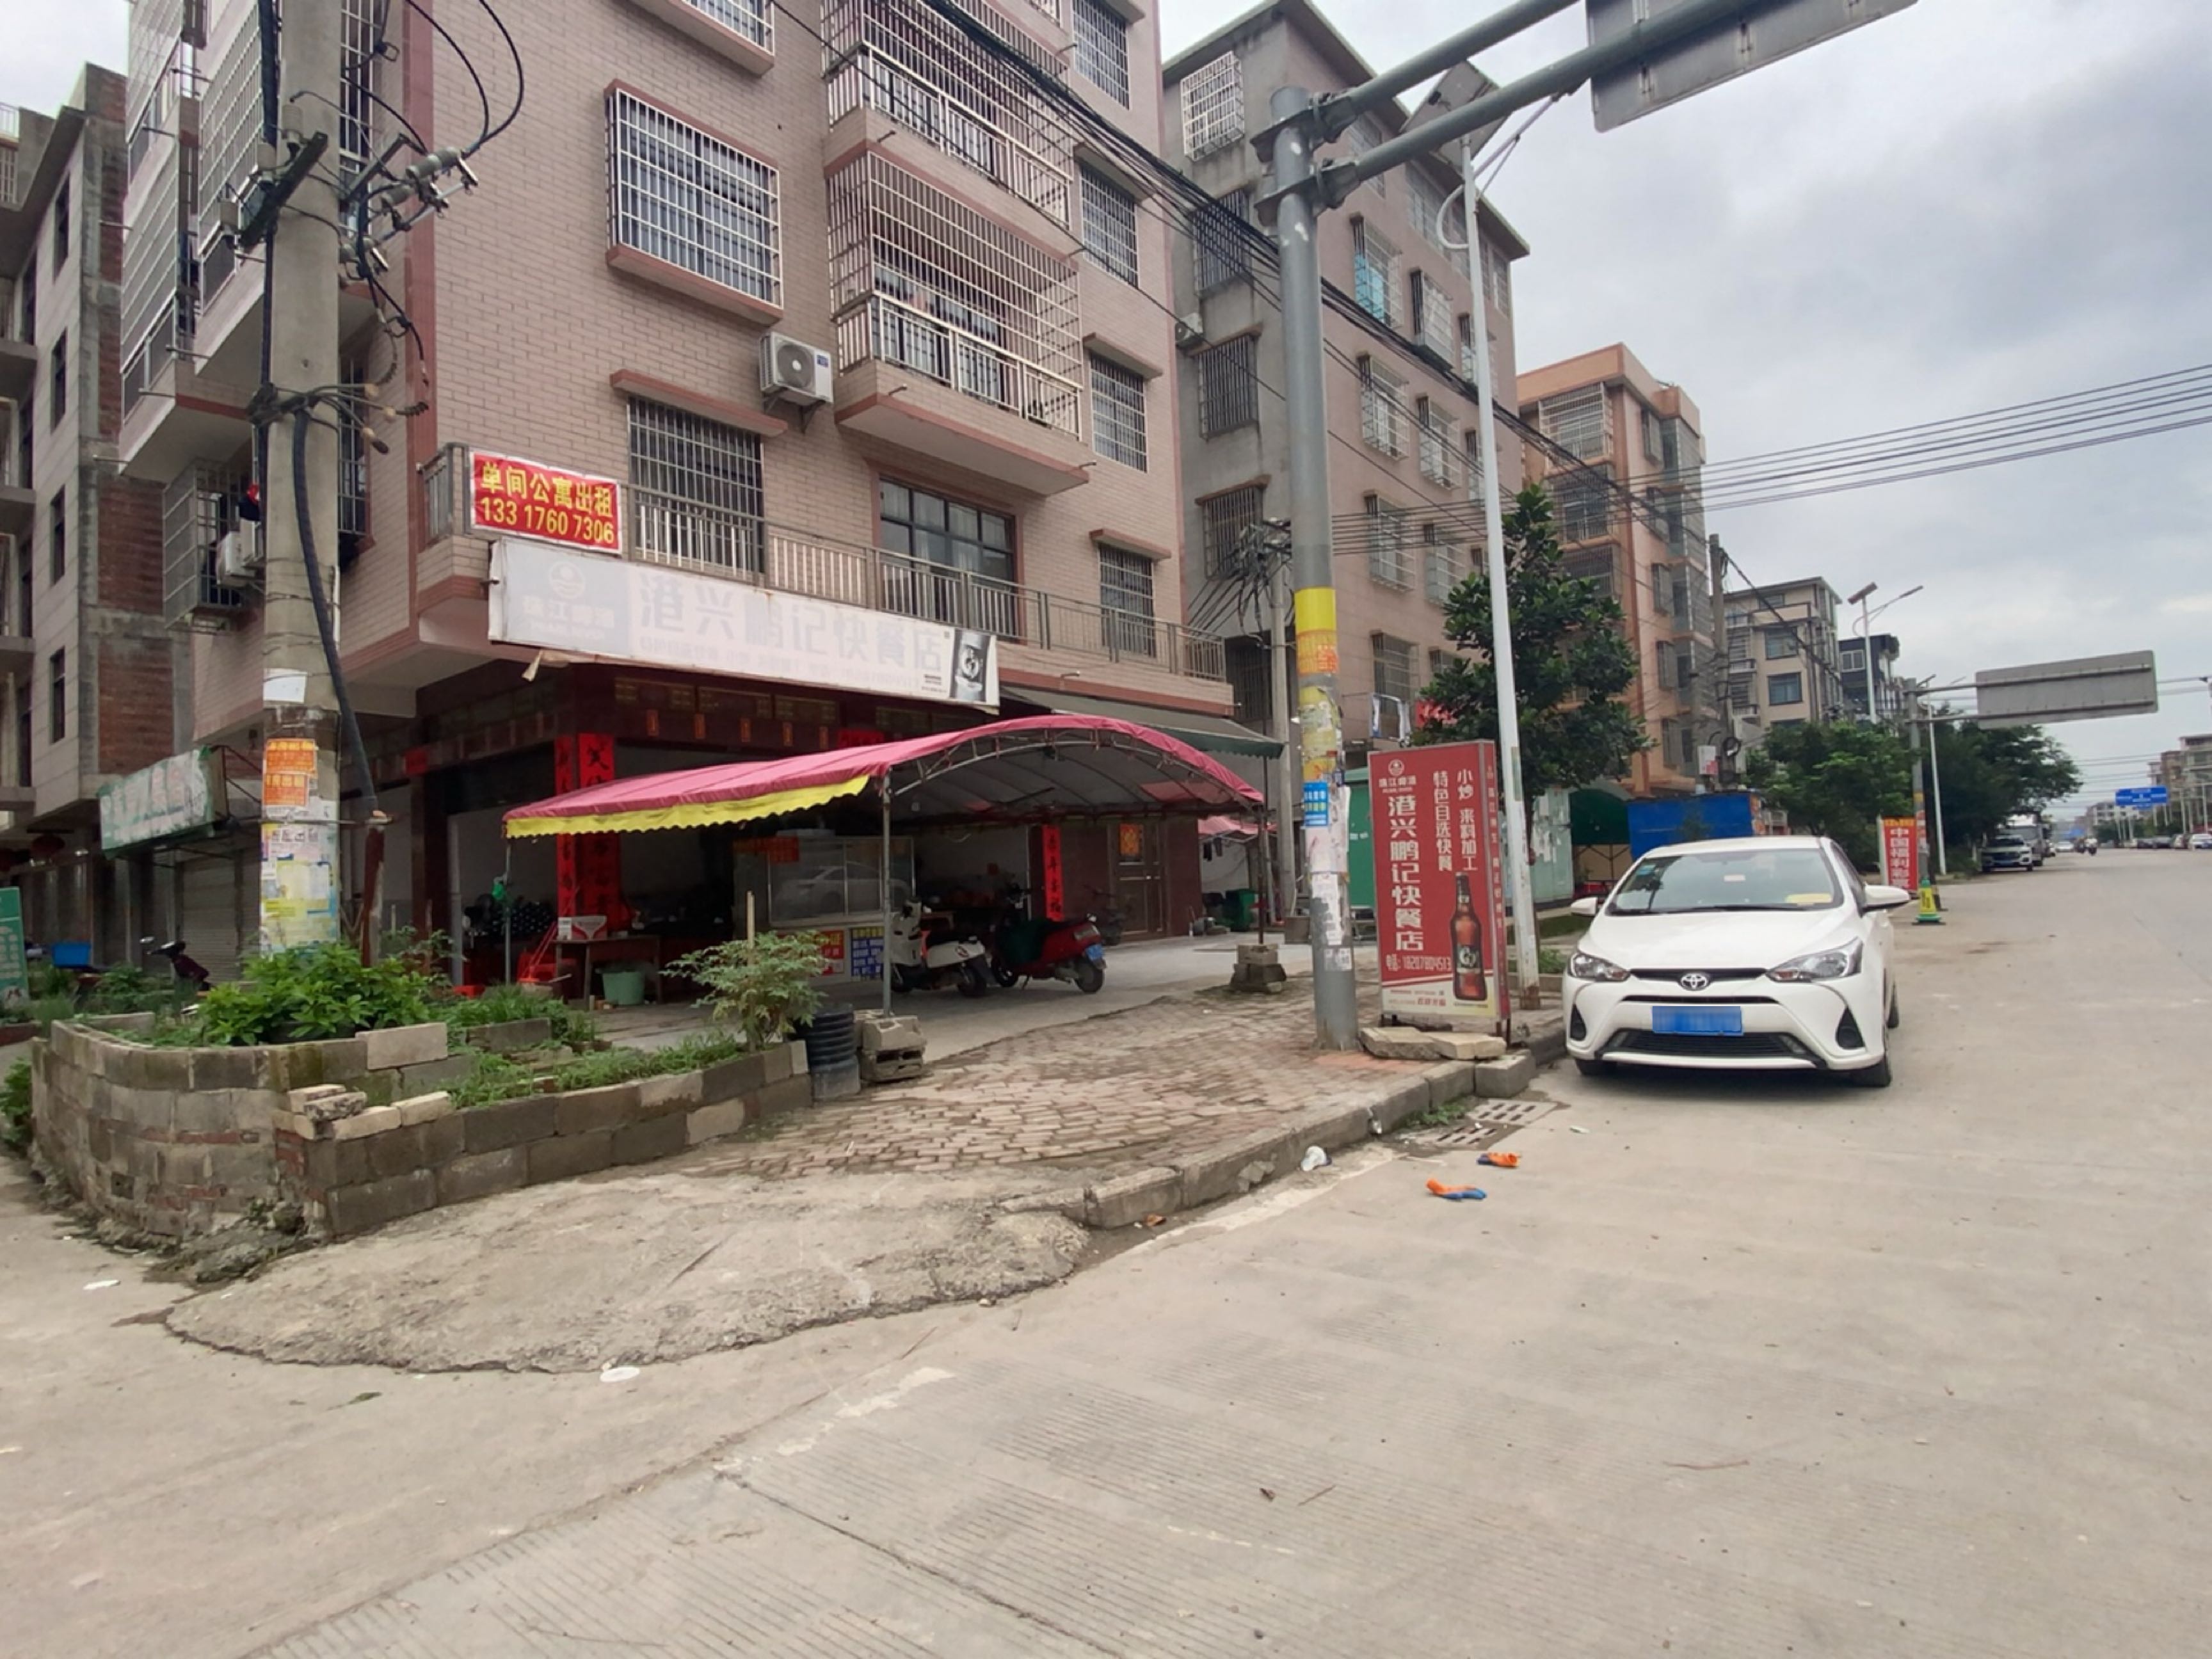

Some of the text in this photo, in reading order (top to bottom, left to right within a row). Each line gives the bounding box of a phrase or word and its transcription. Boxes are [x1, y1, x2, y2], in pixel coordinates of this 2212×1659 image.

[481, 461, 613, 518] 单间公寓出租
[481, 497, 615, 543] 133 1760 7306
[1433, 770, 1452, 872] 特色自选快餐
[1388, 794, 1424, 952] 港兴鹏记快餐店
